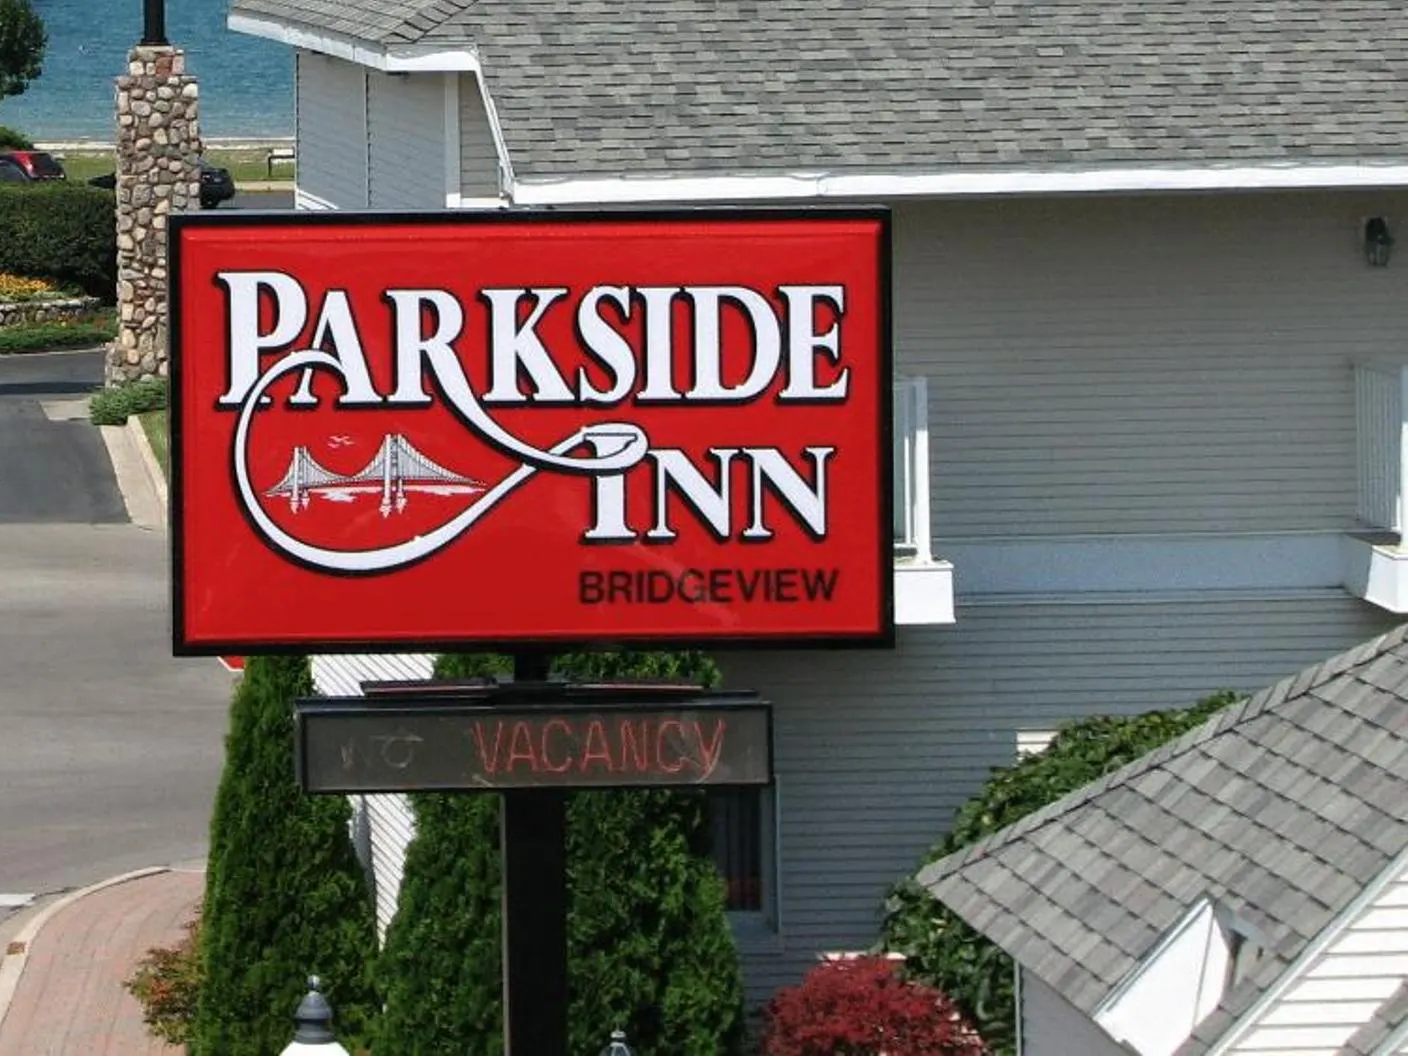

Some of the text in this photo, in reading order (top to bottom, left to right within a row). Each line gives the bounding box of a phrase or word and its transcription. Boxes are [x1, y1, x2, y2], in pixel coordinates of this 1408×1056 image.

[216, 270, 850, 408] PARKSIDE
[579, 426, 837, 542] INN
[578, 569, 839, 604] BRIDGEVIEW
[471, 719, 726, 781] VACANCY
